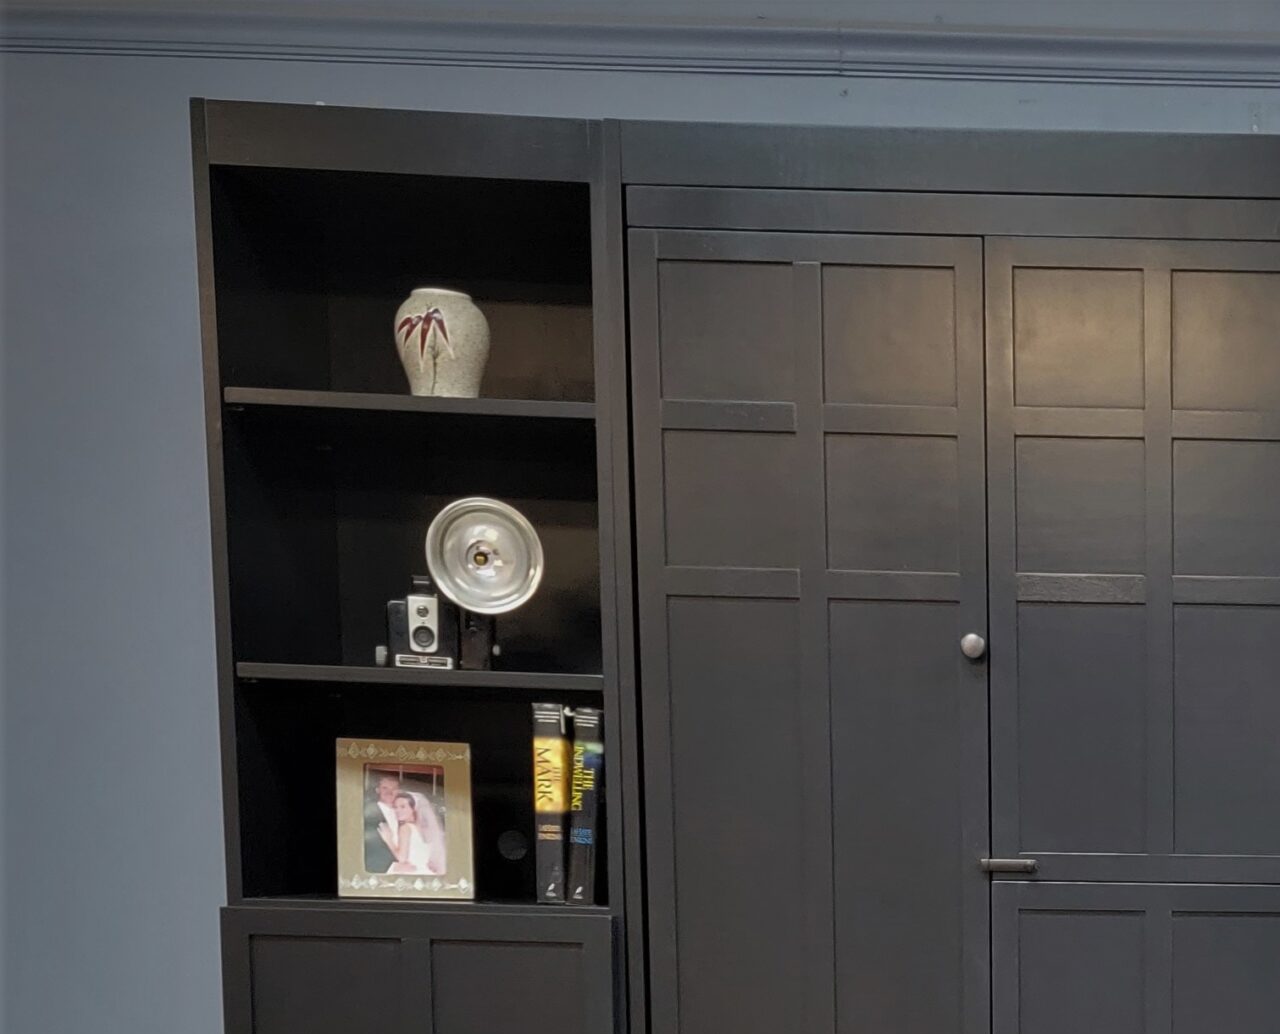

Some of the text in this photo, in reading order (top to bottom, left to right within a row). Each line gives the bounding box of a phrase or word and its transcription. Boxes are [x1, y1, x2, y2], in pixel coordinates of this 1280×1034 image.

[536, 747, 554, 803] MARK
[571, 746, 585, 811] INDWELLING
[583, 768, 595, 791] THE
